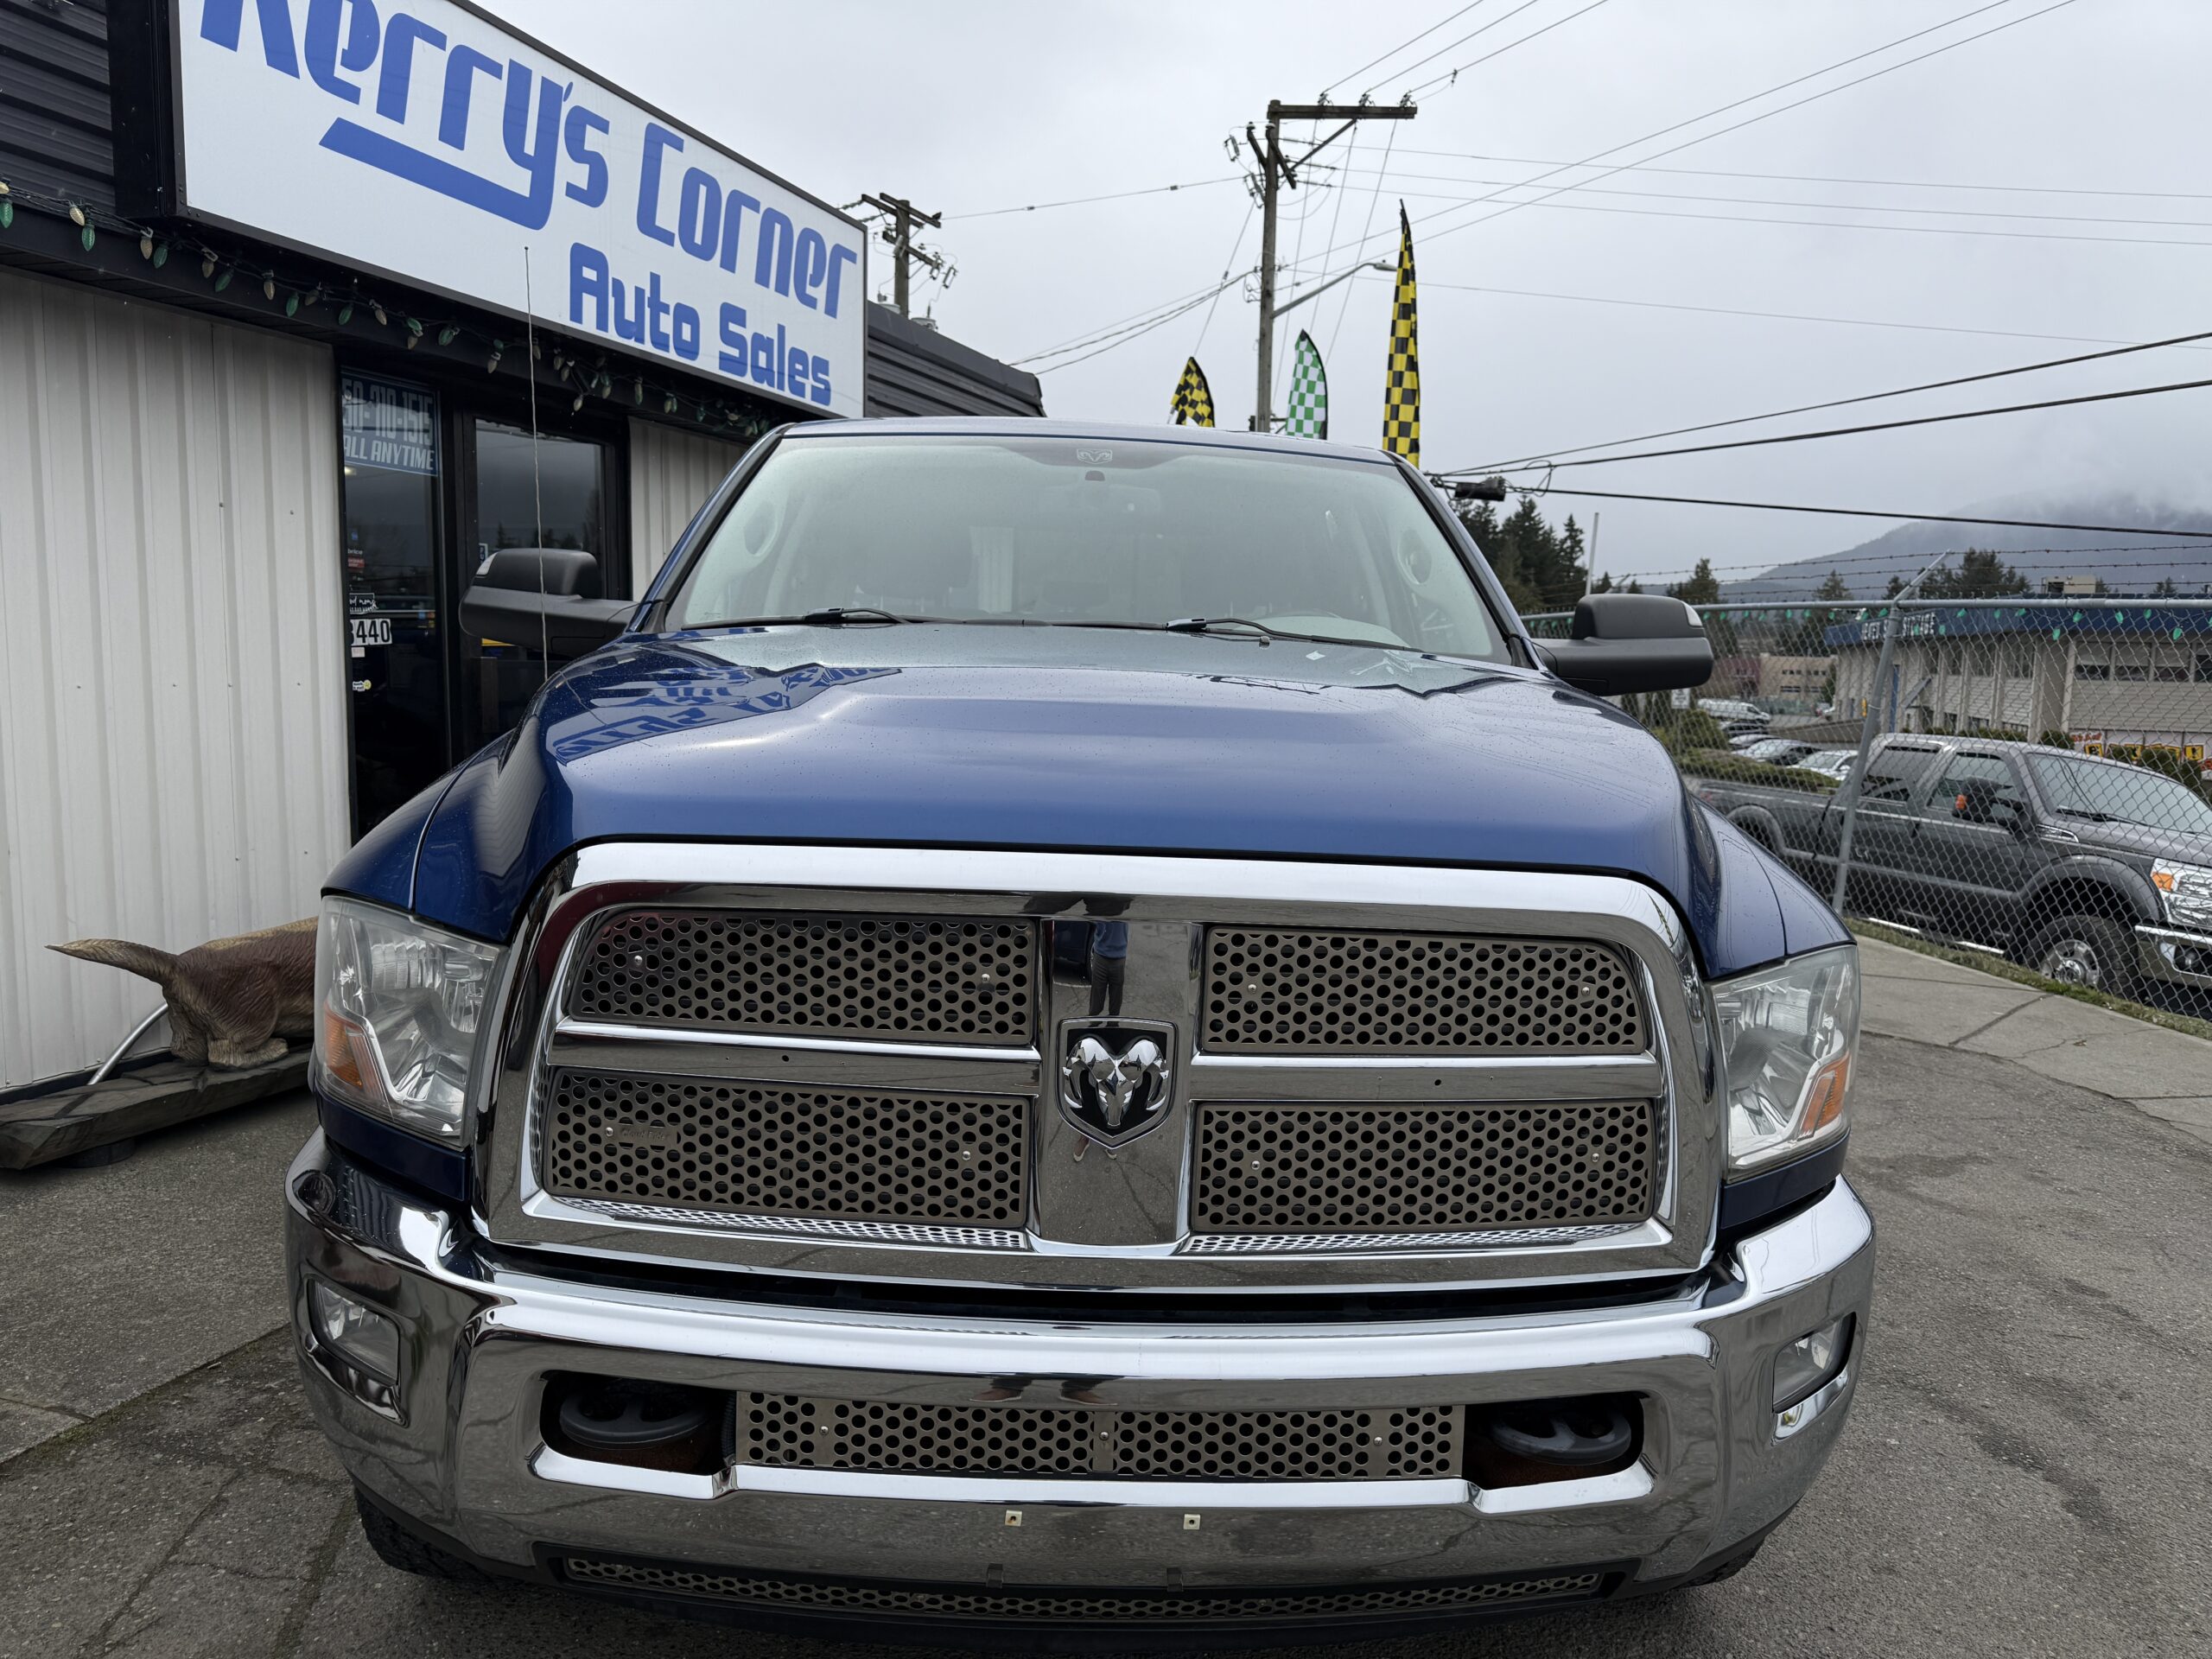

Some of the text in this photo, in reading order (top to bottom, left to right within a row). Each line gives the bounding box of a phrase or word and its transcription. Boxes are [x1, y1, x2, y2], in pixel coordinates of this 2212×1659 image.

[637, 122, 858, 319] Corner
[569, 242, 831, 406] Auto Sales
[370, 440, 435, 470] ANYTIME
